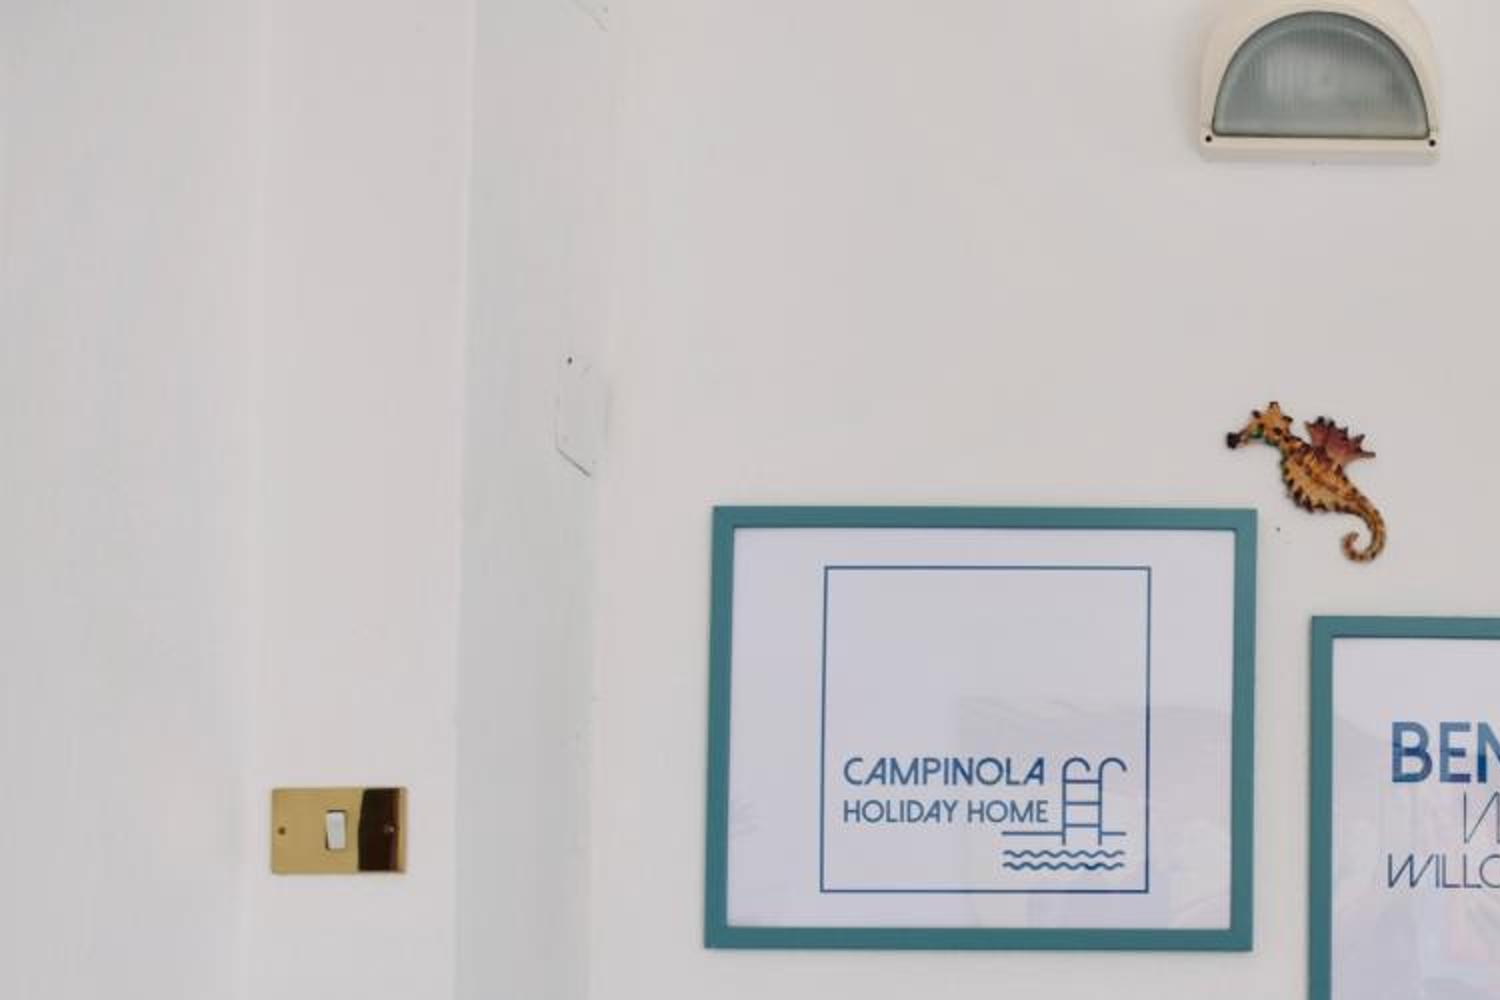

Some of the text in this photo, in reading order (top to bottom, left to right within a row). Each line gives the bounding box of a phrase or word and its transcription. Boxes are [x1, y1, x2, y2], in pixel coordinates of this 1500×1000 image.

[843, 757, 1045, 786] CAMPINOLA
[842, 799, 1049, 824] HOLIDAY HOME
